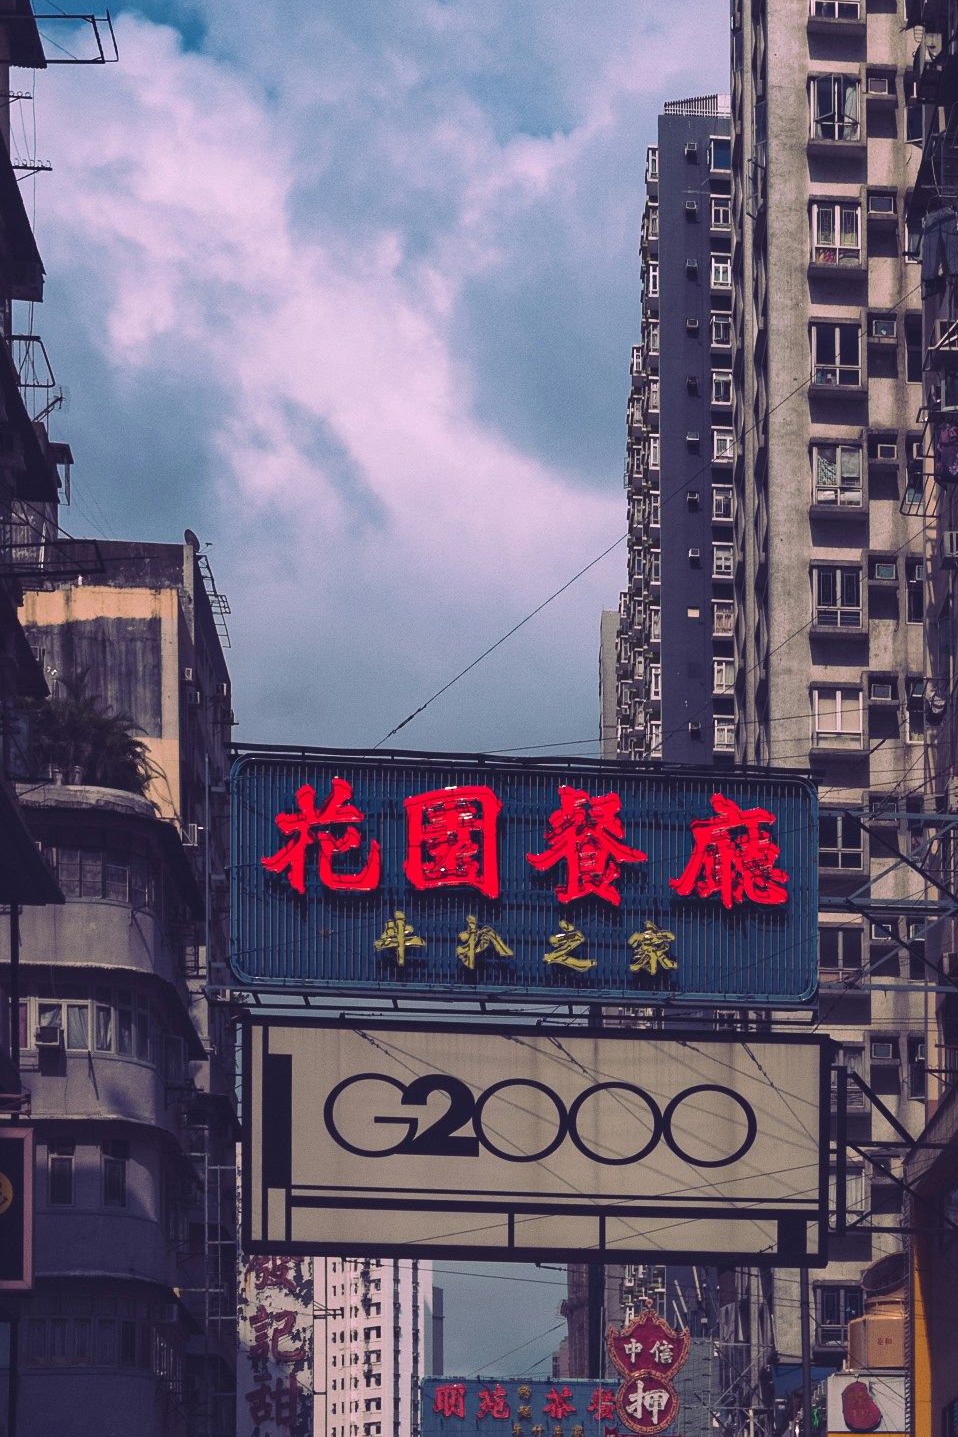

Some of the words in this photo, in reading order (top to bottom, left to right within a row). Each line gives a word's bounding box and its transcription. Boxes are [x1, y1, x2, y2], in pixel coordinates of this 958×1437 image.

[262, 778, 788, 909] 花園餐廳
[374, 911, 677, 975] 牛扒之家
[323, 1072, 758, 1168] G2000
[624, 1339, 673, 1363] 中信
[628, 1379, 670, 1425] 押
